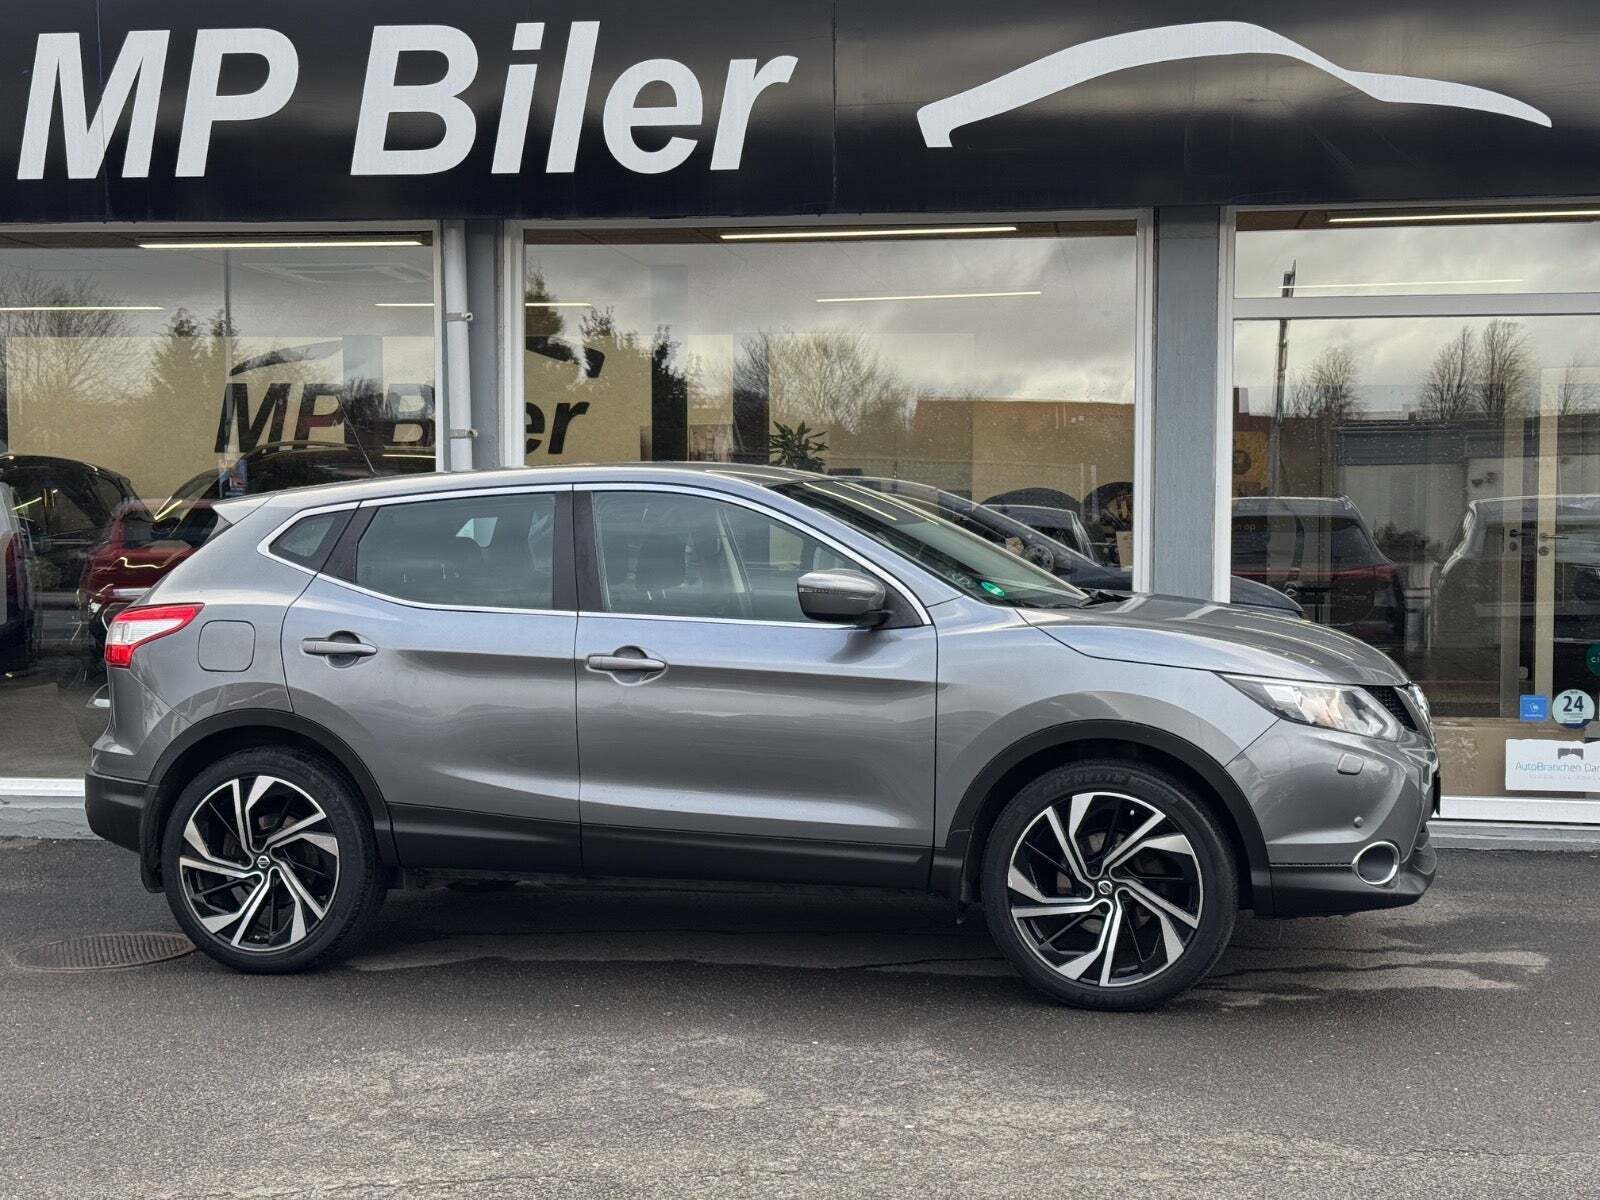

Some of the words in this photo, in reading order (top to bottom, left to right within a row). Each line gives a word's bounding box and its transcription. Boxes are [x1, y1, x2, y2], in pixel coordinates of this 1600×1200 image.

[18, 28, 299, 180] MP
[350, 21, 798, 176] Biler
[214, 382, 346, 455] MP
[1562, 695, 1584, 712] 24
[1515, 761, 1582, 773] AutoBranchen
